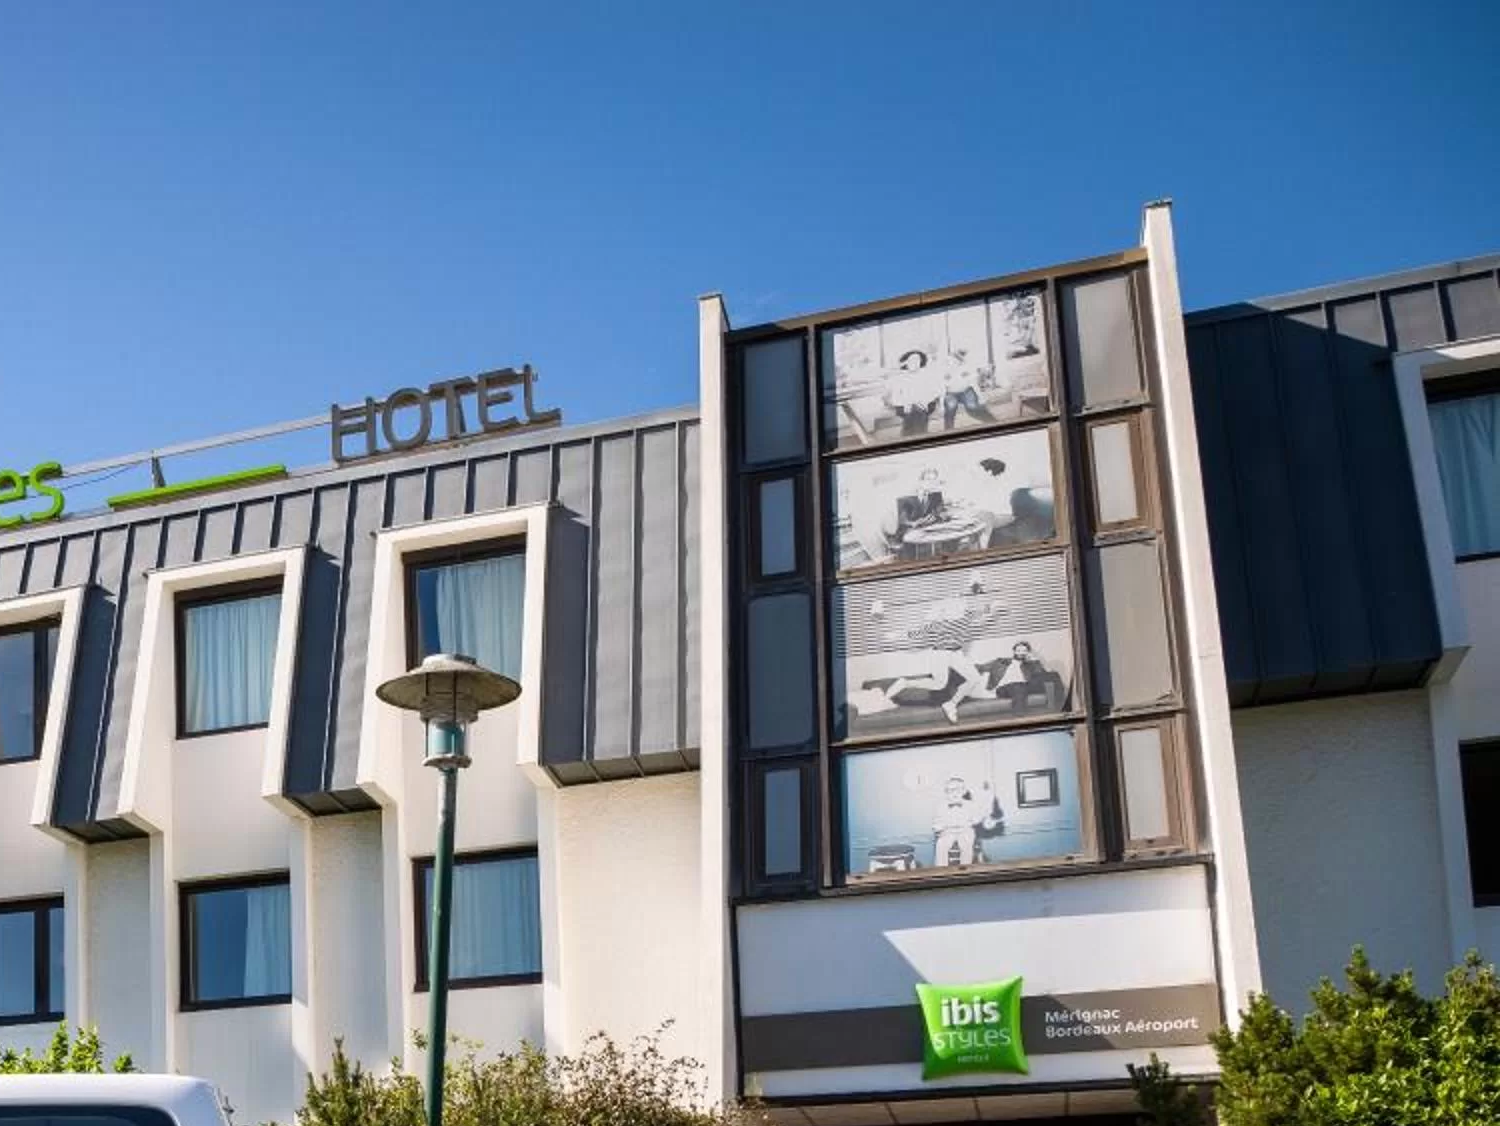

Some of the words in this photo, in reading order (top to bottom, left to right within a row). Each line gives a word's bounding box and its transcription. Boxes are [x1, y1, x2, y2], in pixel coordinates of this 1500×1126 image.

[331, 364, 560, 464] HOTEL
[940, 996, 1000, 1027] ibis
[1045, 1008, 1121, 1023] Mérignac
[1045, 1023, 1122, 1039] Bordeaux
[1125, 1016, 1200, 1034] Aéroport
